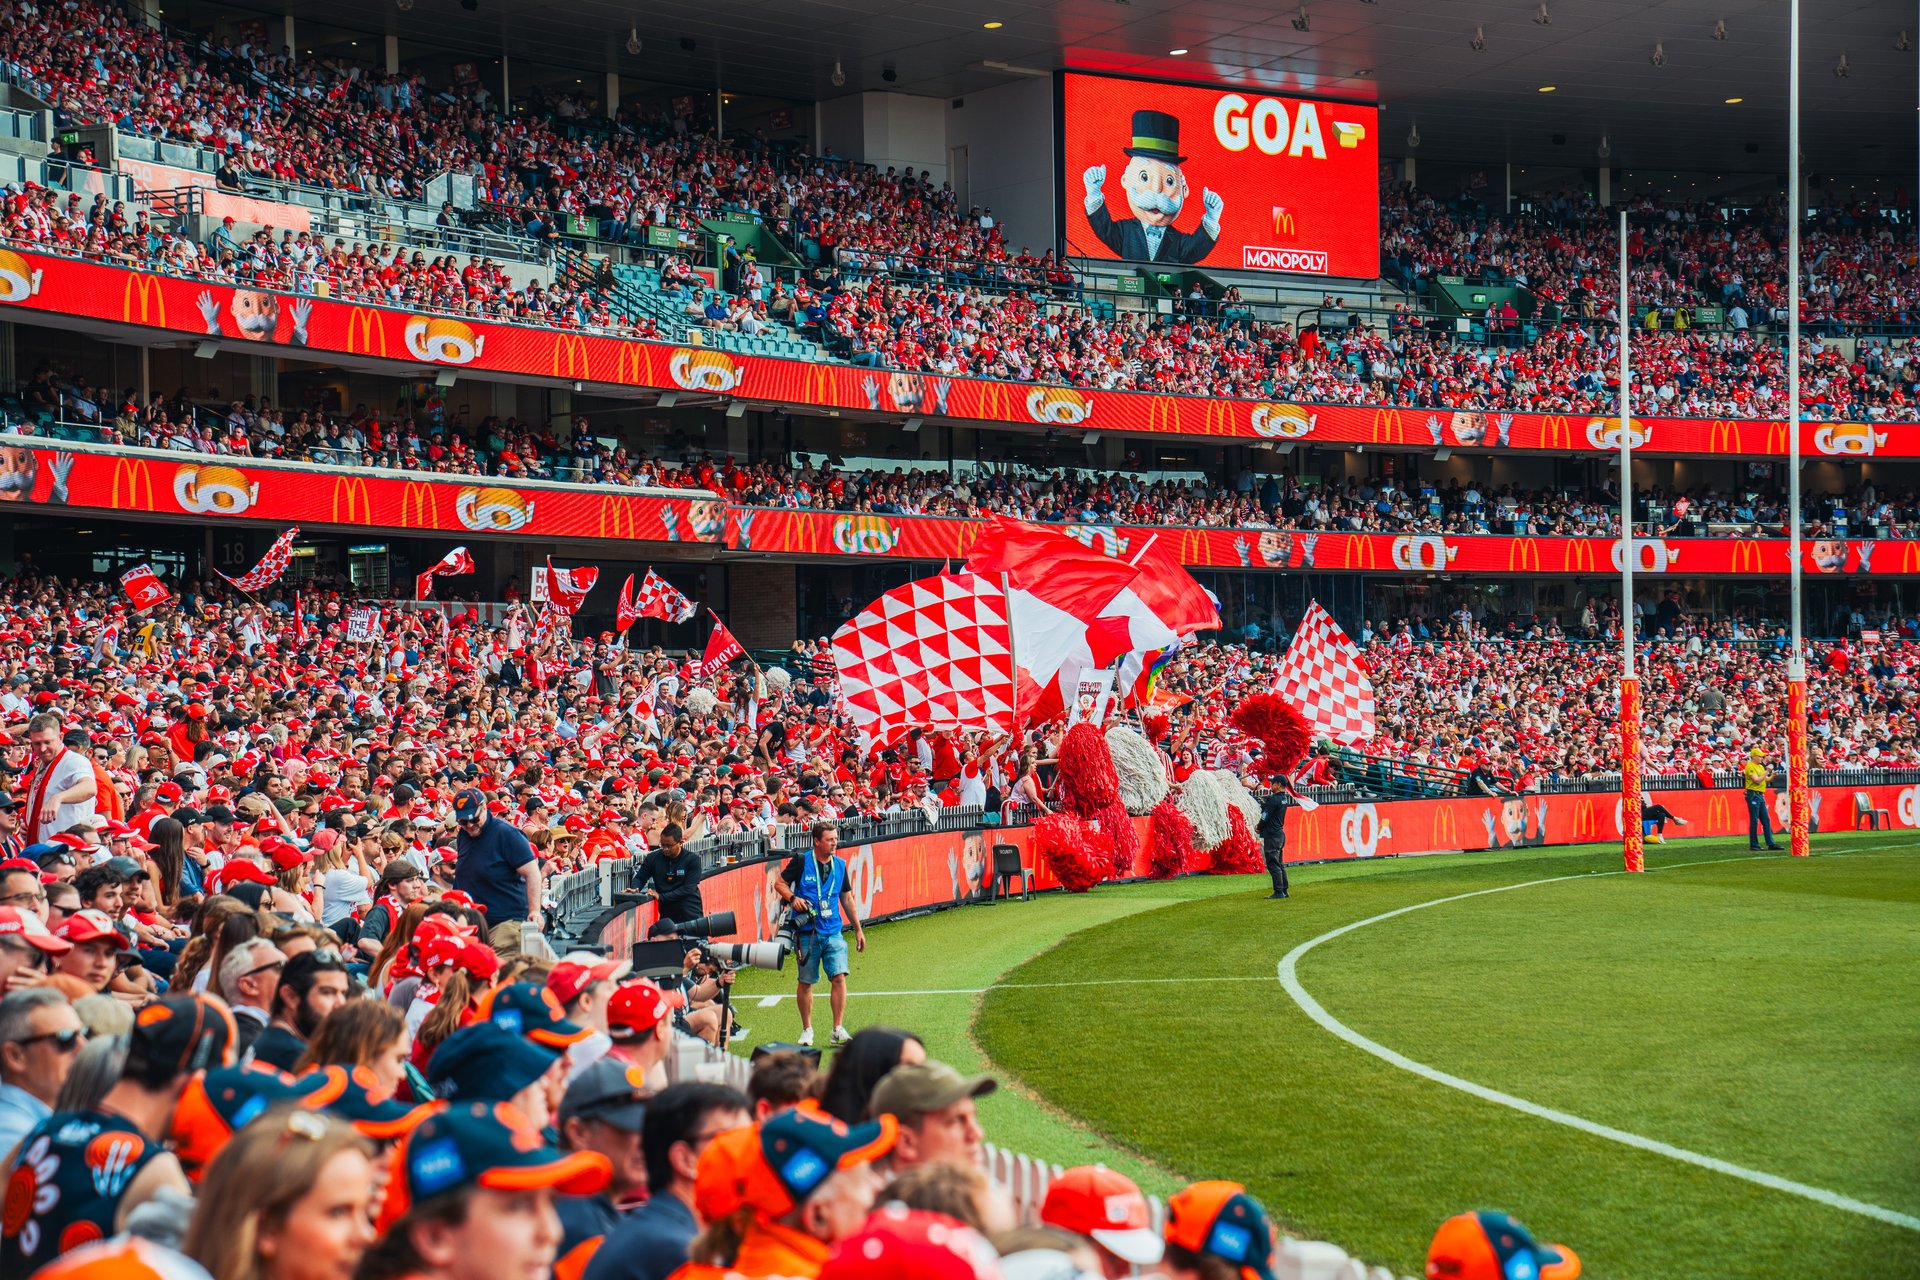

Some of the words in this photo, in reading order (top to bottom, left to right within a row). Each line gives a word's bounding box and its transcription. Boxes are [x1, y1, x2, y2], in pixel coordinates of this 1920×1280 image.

[1247, 249, 1326, 272] MONOPOLY
[222, 542, 245, 565] 18
[350, 620, 367, 630] THE
